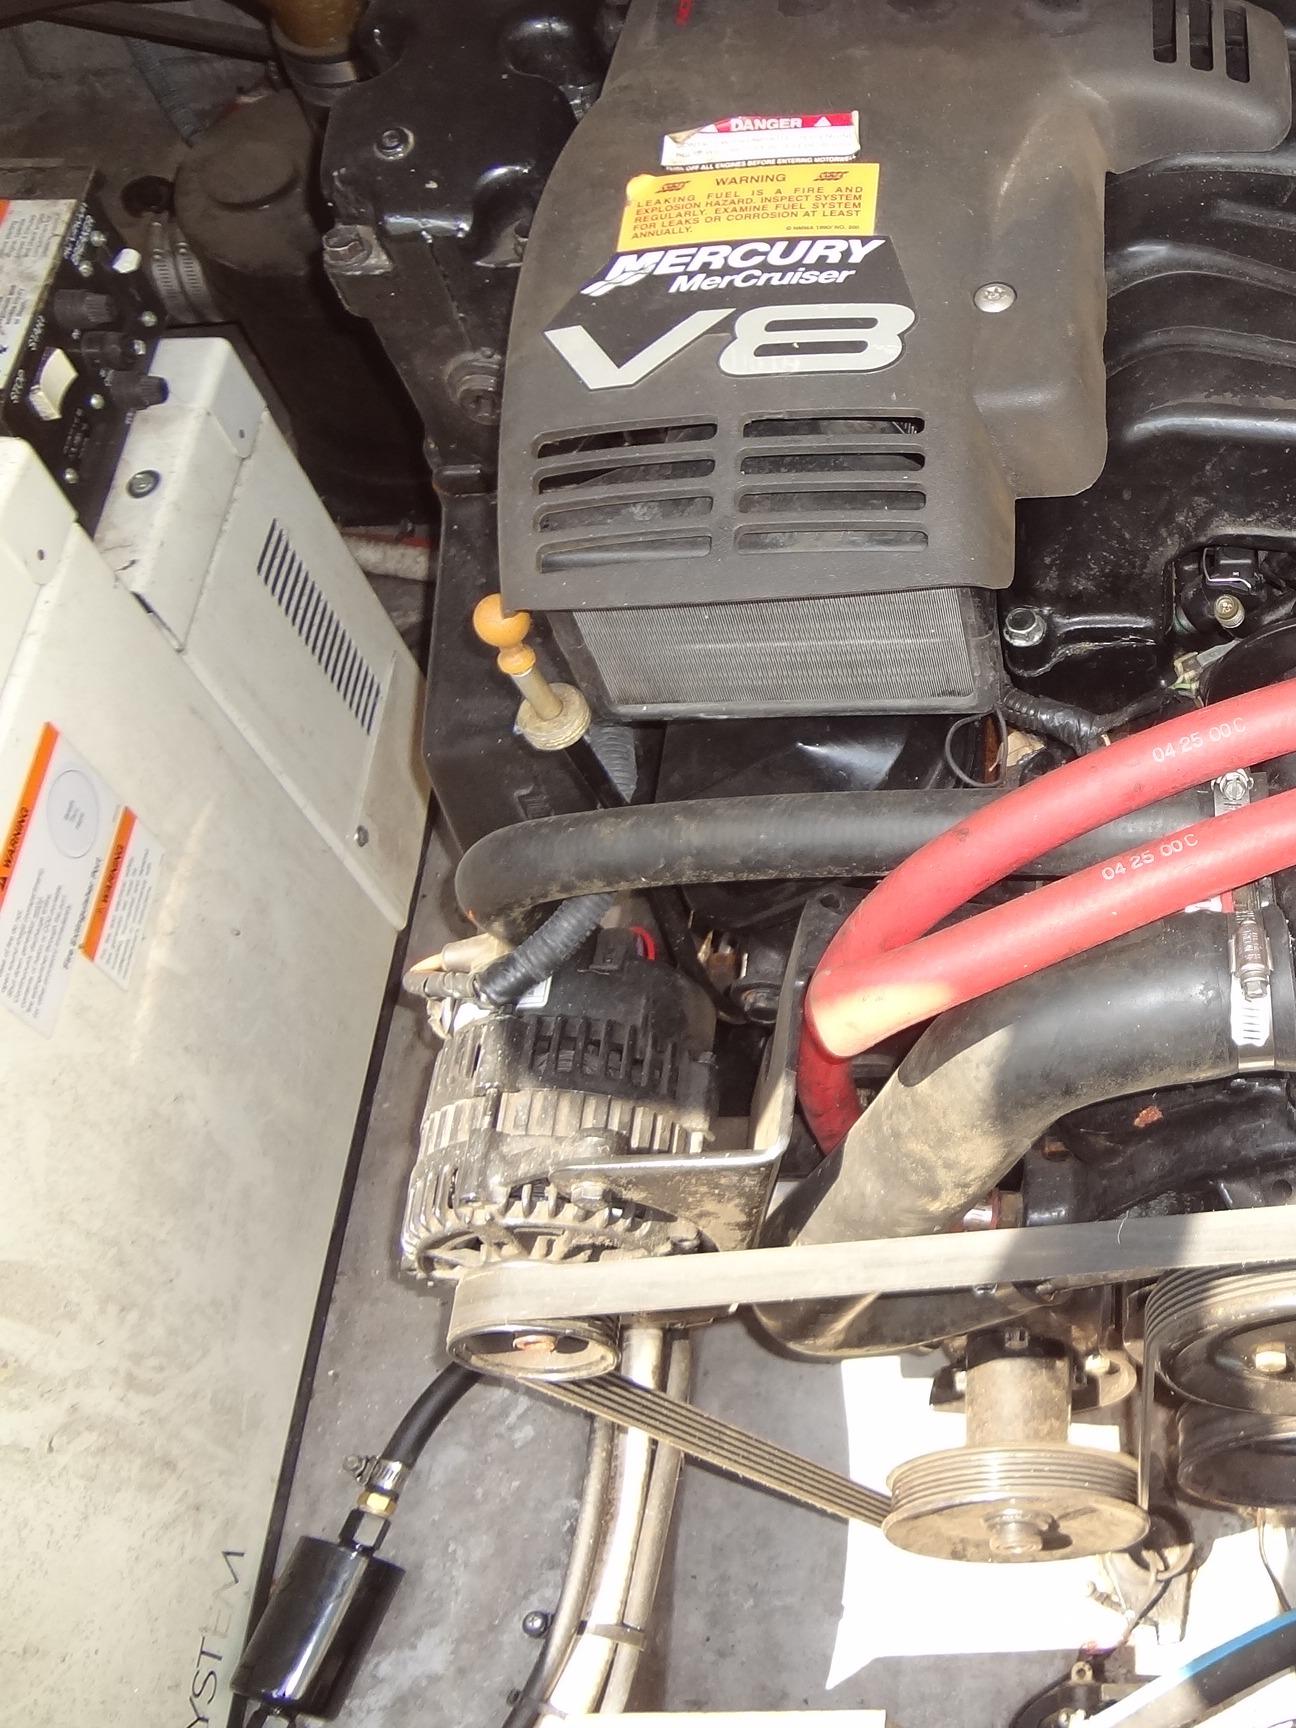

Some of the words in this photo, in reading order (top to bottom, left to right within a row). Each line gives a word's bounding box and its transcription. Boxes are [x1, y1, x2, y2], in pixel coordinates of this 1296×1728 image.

[730, 117, 802, 132] DANGER
[715, 161, 746, 169] ENGINES
[777, 157, 812, 165] ENTERING
[716, 174, 786, 186] WARNING
[636, 202, 701, 216] EXPLOSION
[706, 198, 756, 207] HAZARD.
[761, 195, 810, 203] INSPECT
[637, 195, 696, 207] LEAKING
[707, 191, 740, 199] FUEL
[715, 204, 768, 214] EXAMINE
[633, 223, 656, 231] FOR
[662, 217, 700, 228] LEAKS
[726, 211, 798, 221] CORROSION
[822, 209, 861, 217] LEAST
[632, 226, 693, 239] ANNUALLY.
[598, 239, 885, 283] MERCURY
[668, 267, 855, 293] MerCruiser
[544, 303, 915, 390] V8
[1153, 743, 1176, 762] 04
[1181, 731, 1204, 752] 25
[3, 806, 28, 868] WARNING
[1101, 862, 1127, 881] 04
[1130, 851, 1154, 871] 25
